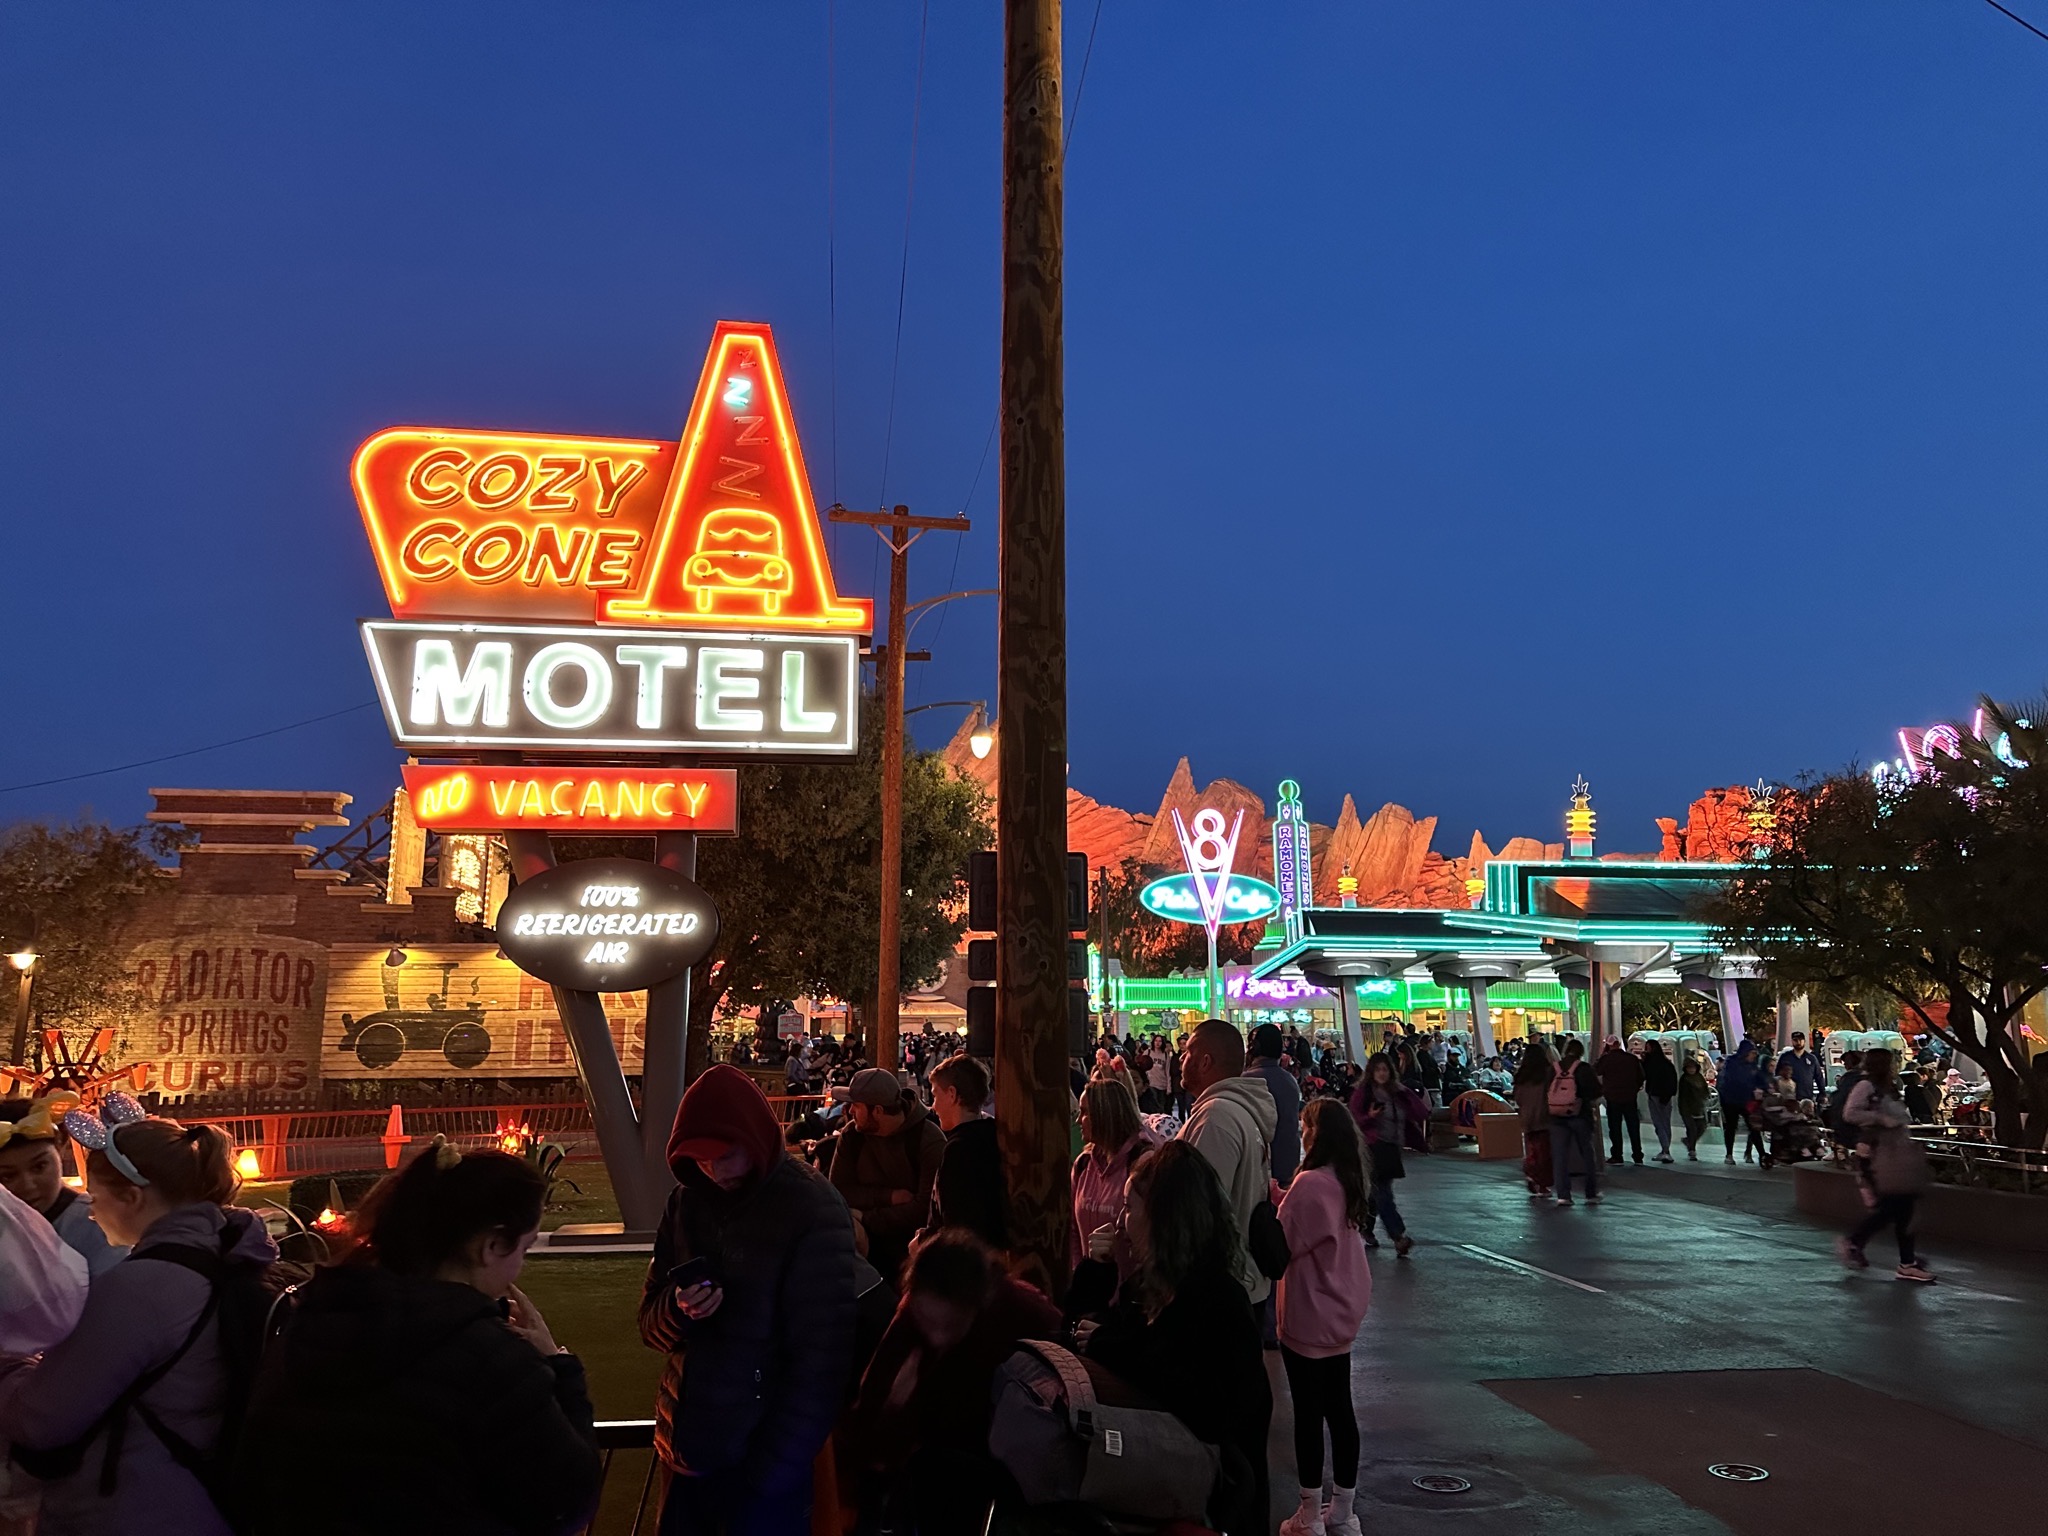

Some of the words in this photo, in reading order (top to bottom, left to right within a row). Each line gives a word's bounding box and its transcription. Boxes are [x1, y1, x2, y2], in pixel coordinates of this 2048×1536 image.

[408, 449, 647, 516] COZY
[402, 519, 642, 588] CONE
[410, 639, 837, 732] MOTEL
[421, 776, 468, 816] NO
[489, 779, 709, 818] VACANCY
[1278, 826, 1294, 904] RAMONES
[580, 885, 641, 908] 100%
[513, 913, 698, 937] REFRIGERATED
[136, 948, 315, 1009] RADIATOR
[584, 942, 630, 964] AIR
[157, 1008, 290, 1055] SPRINGS
